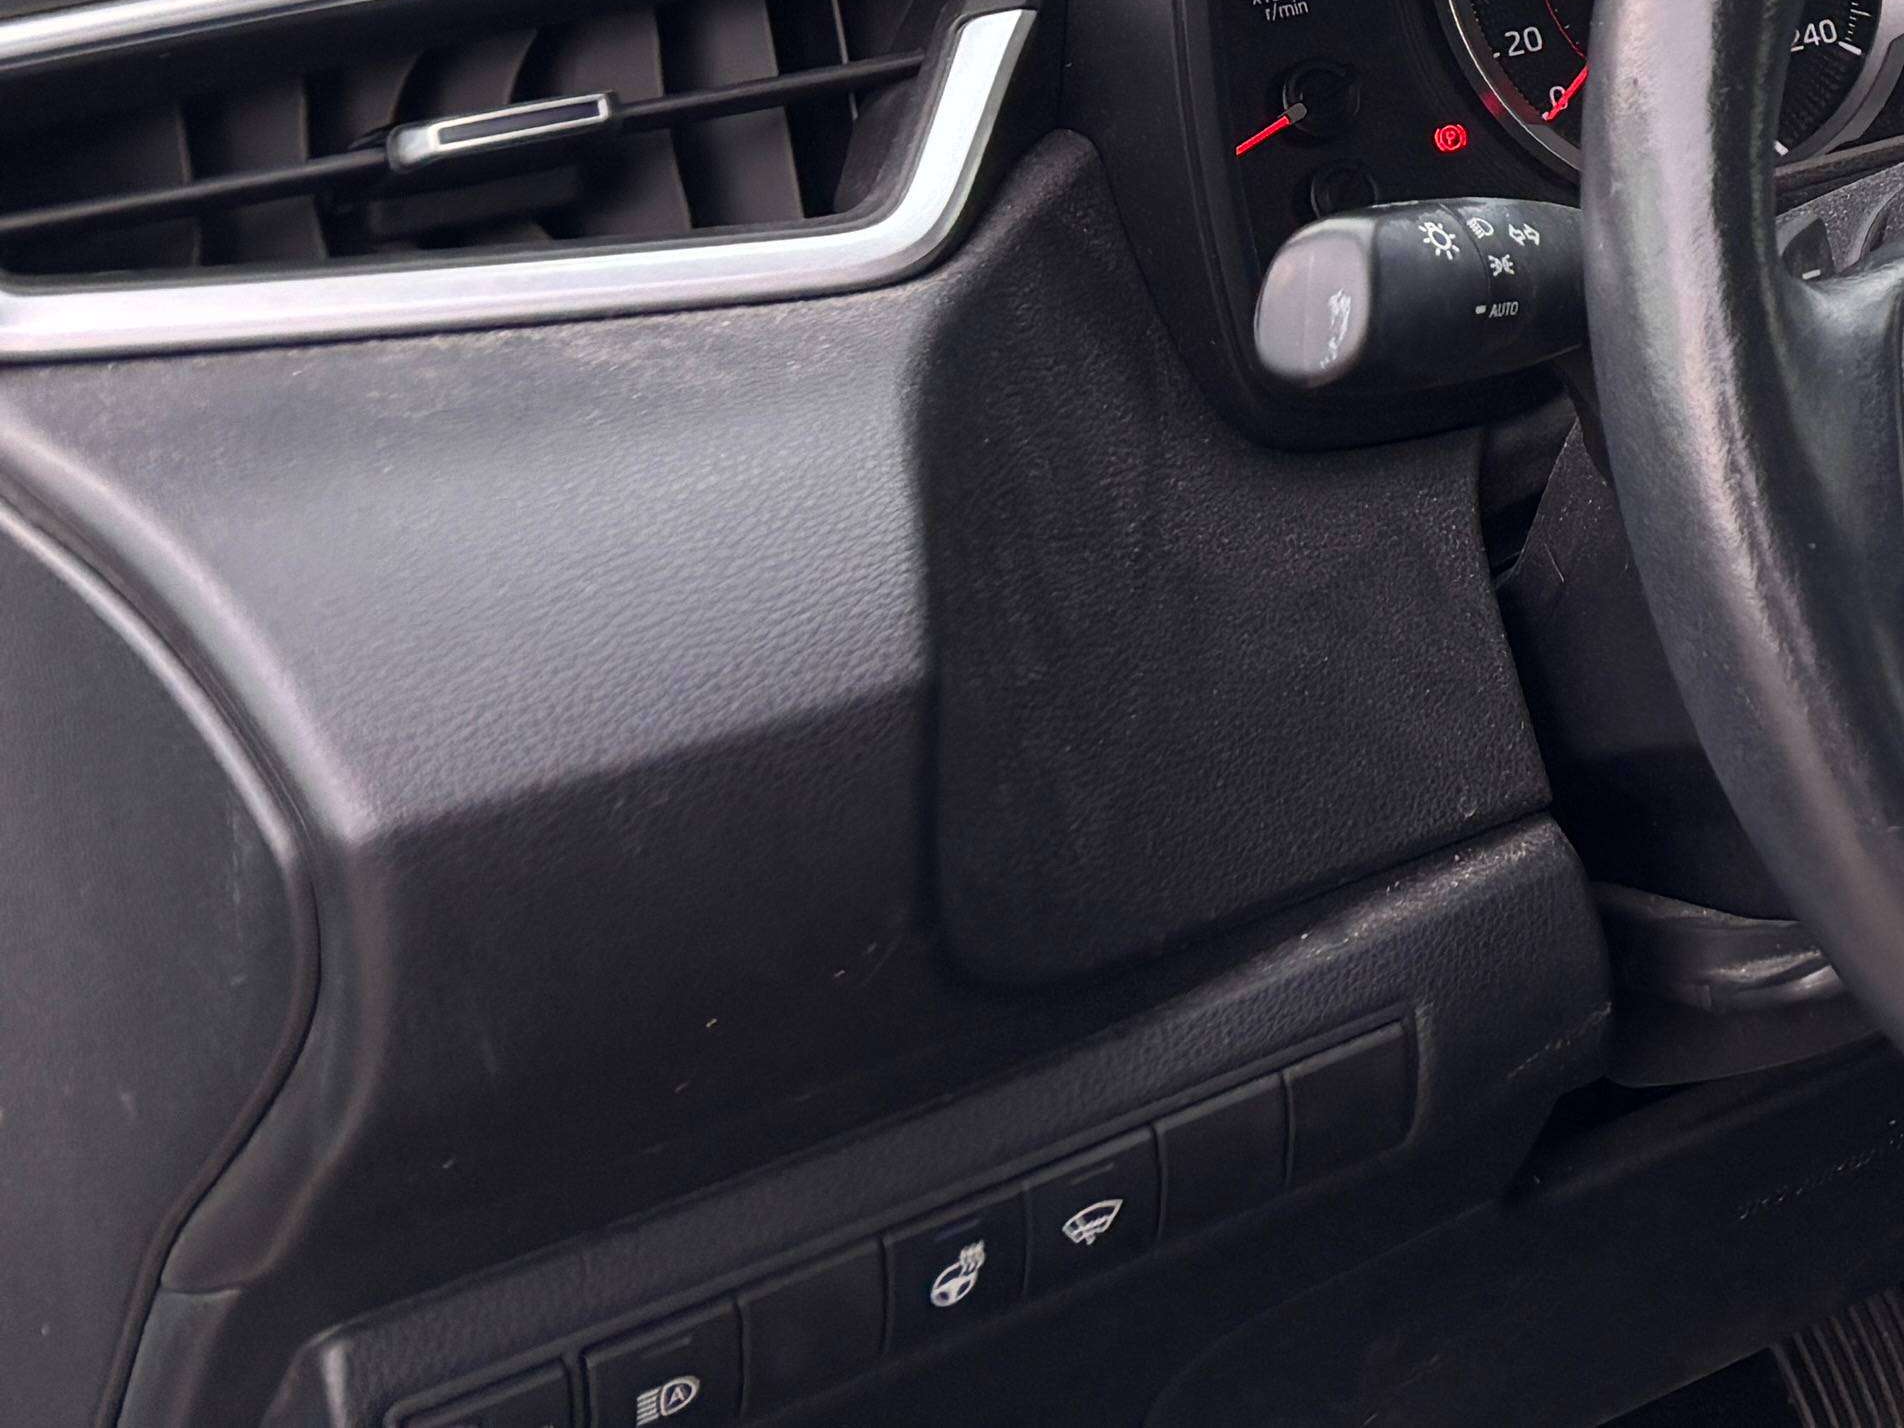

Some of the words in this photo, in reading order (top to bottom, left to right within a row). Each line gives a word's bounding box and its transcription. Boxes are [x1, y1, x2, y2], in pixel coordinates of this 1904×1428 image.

[1265, 0, 1309, 22] r/min
[1504, 26, 1543, 57] 20
[1549, 85, 1569, 111] 0
[1488, 301, 1519, 318] AUTO
